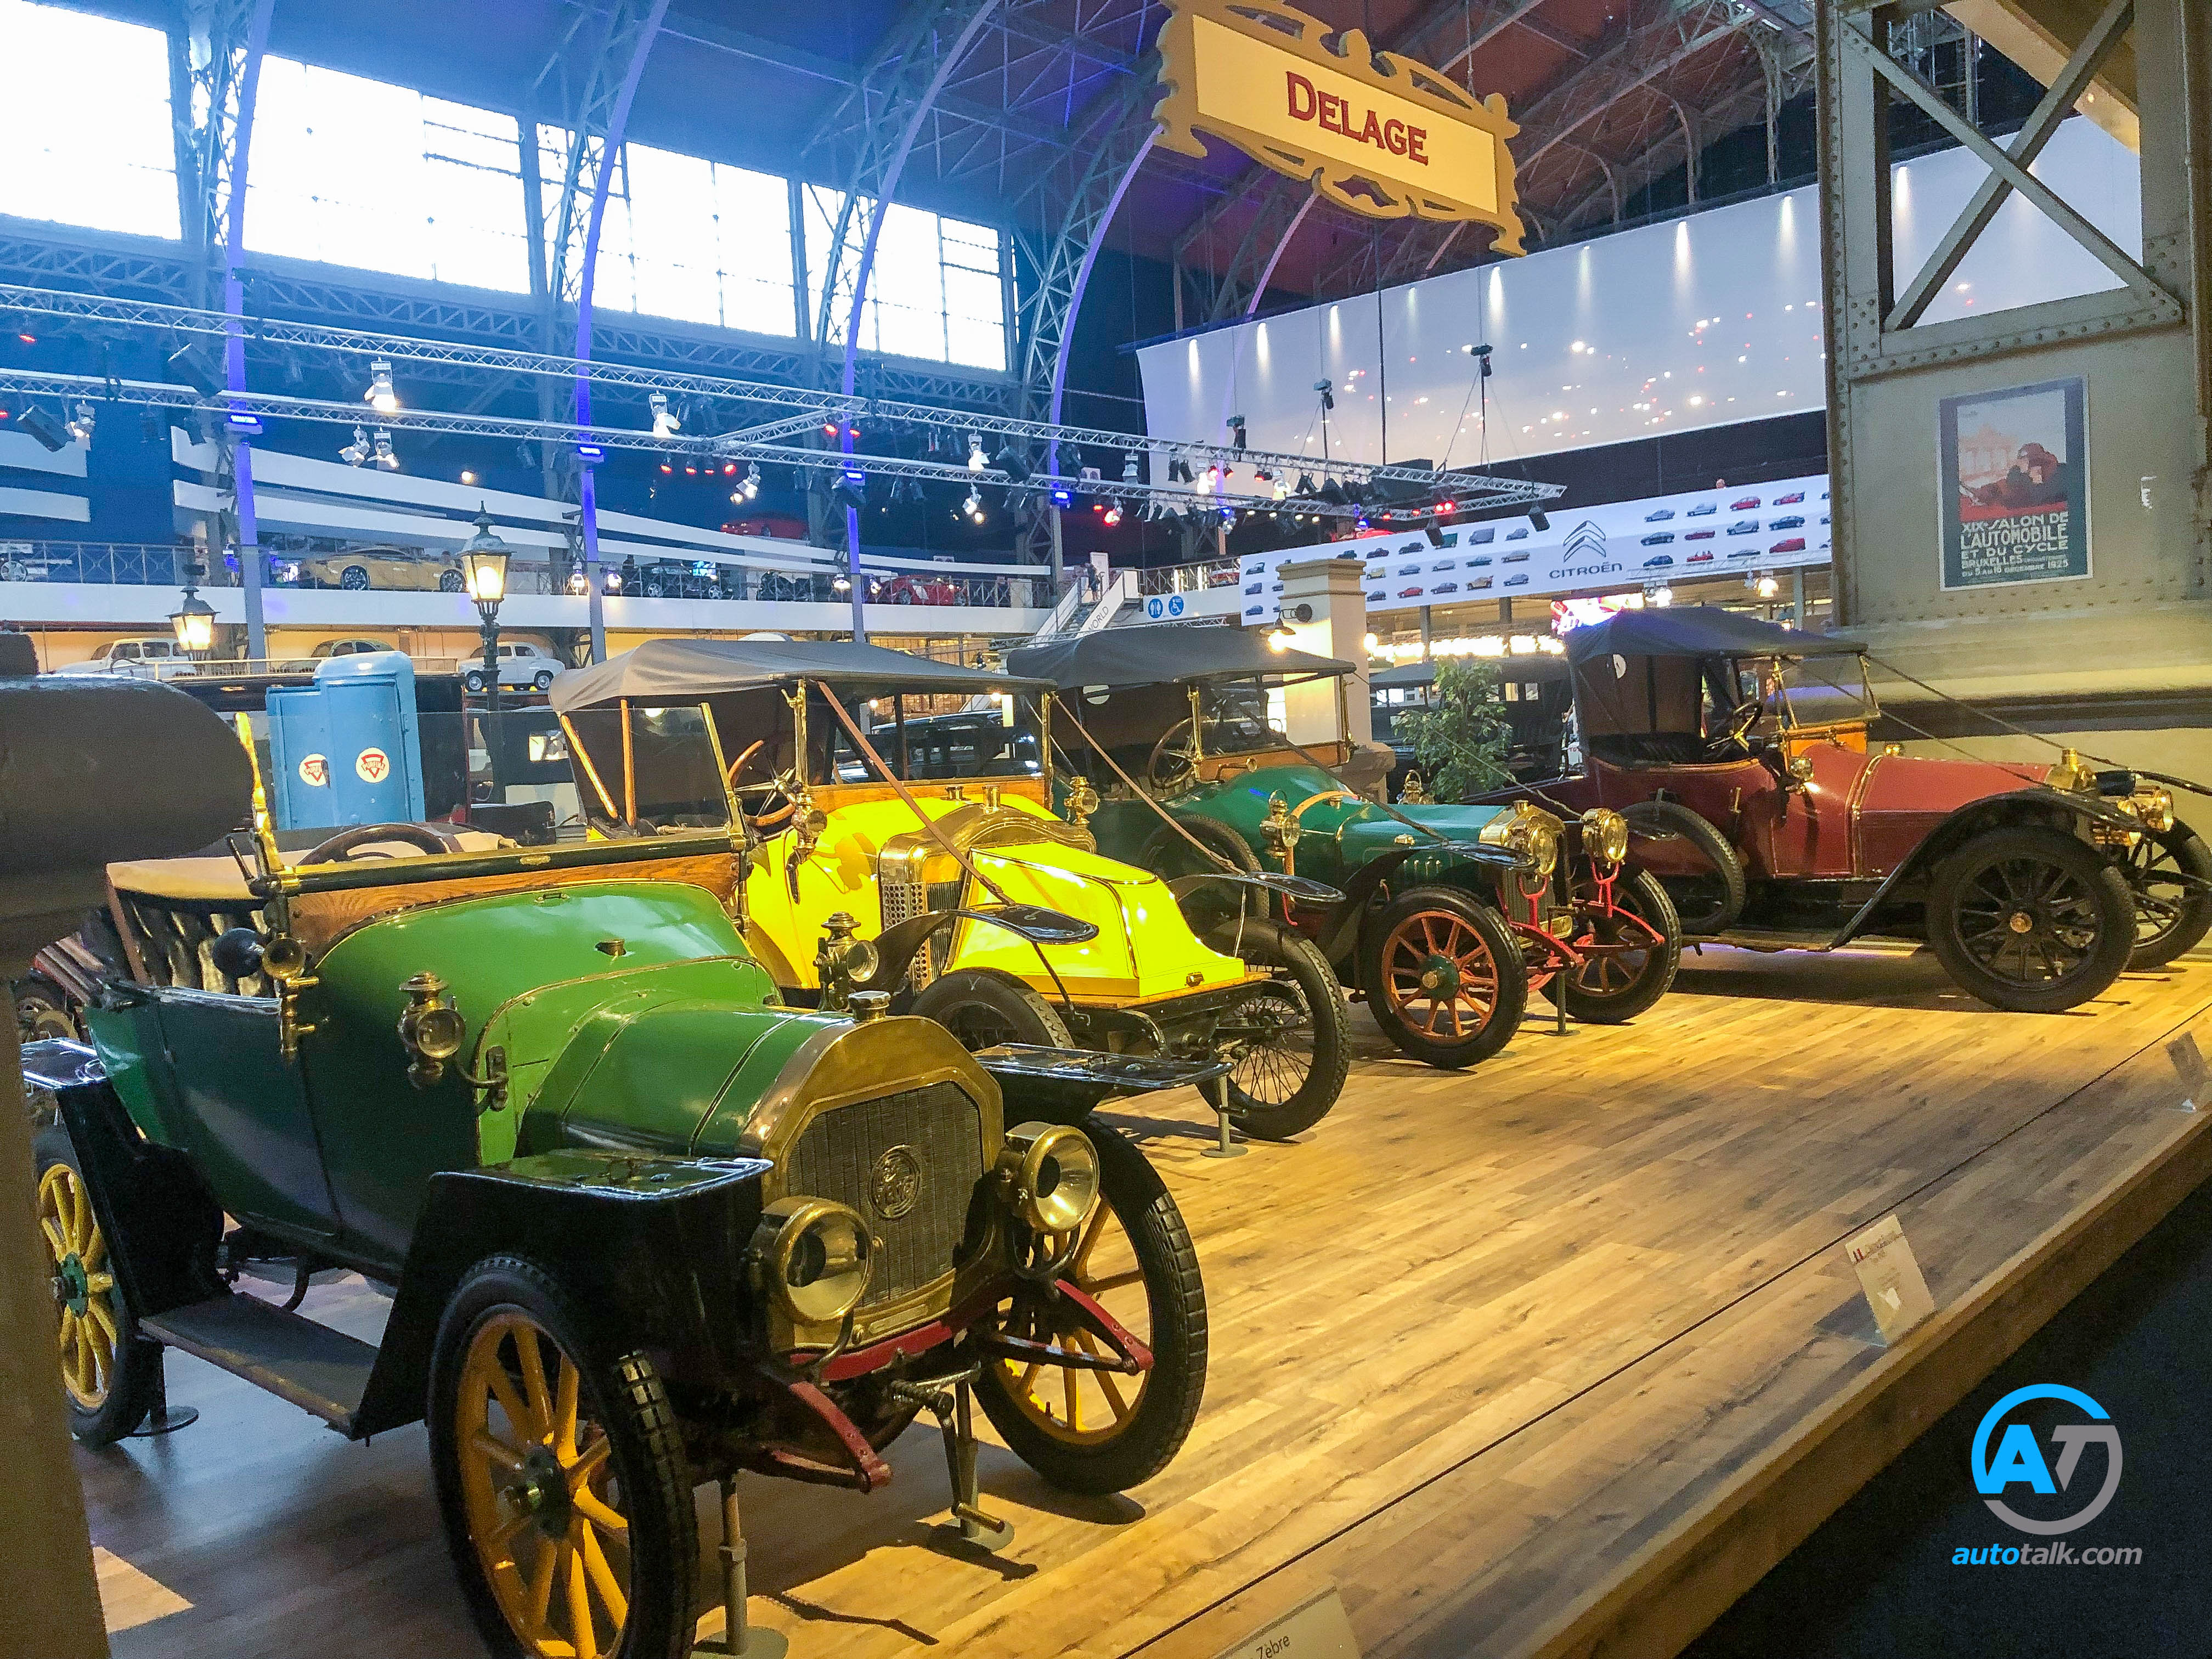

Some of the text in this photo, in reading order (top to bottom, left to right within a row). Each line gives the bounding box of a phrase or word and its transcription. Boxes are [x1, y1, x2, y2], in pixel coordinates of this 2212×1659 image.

[1286, 71, 1429, 166] DELAGE
[1989, 514, 2045, 530] SALON
[2049, 511, 2069, 524] DE
[1960, 522, 2069, 550] L'AUTOMOBILE
[1961, 539, 2069, 560] ET DU CYCLE
[1961, 554, 2023, 569] BRUXELLES
